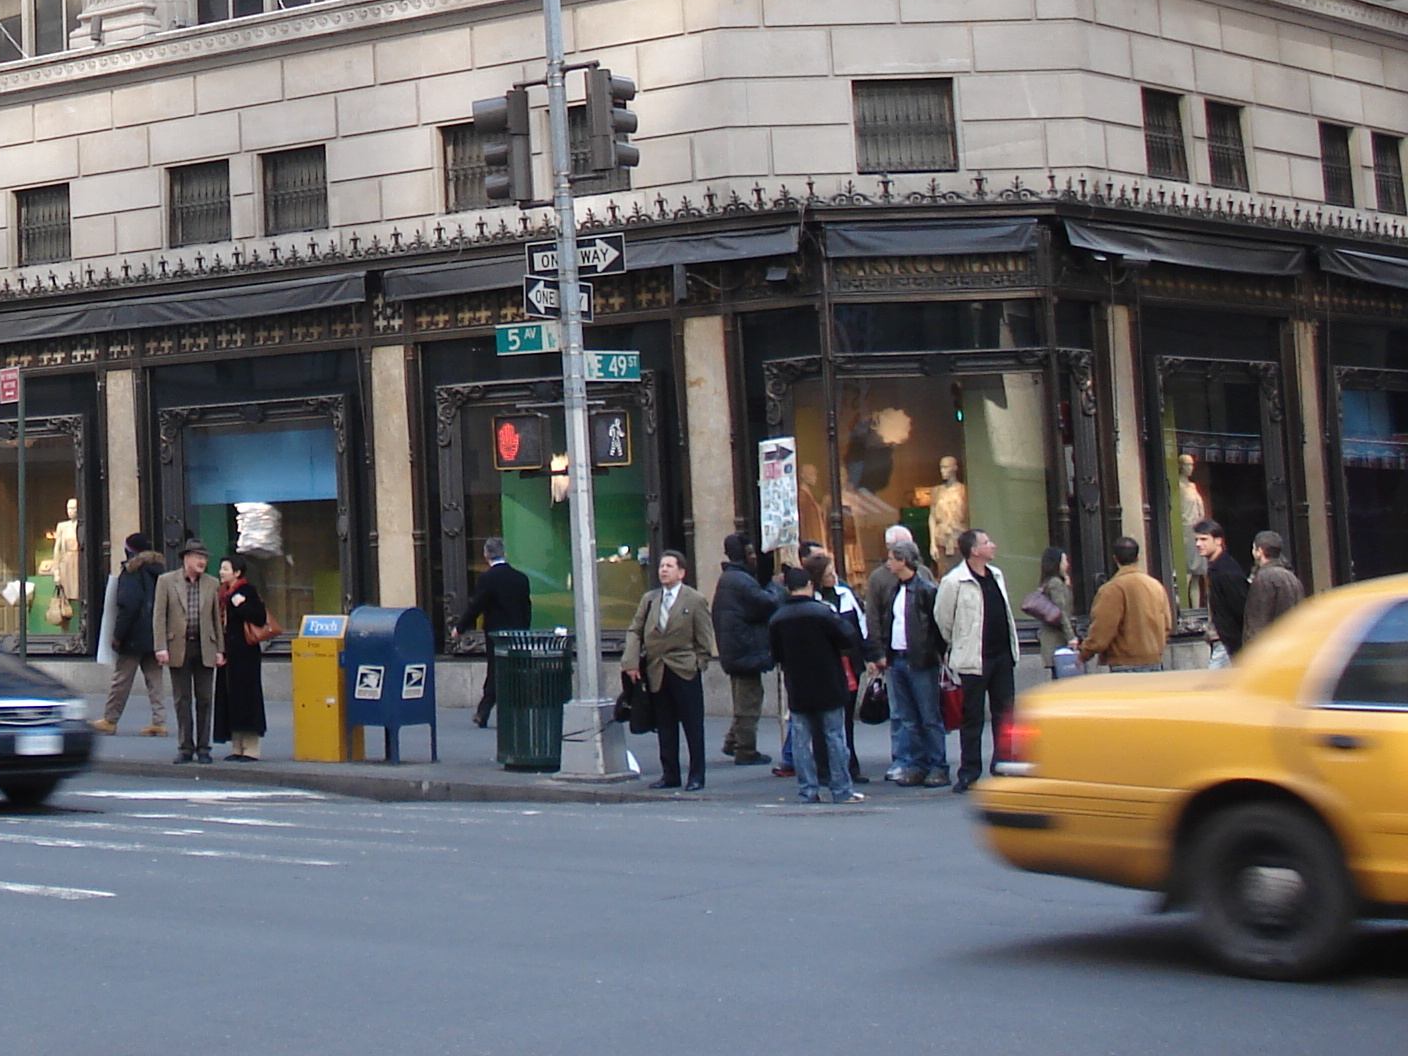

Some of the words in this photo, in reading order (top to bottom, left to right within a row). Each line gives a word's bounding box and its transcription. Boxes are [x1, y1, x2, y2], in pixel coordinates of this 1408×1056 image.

[541, 254, 559, 268] ON
[580, 248, 609, 264] WAY
[535, 289, 555, 305] ONE
[507, 328, 521, 351] 5
[524, 327, 536, 339] AV
[594, 355, 604, 377] E
[608, 355, 627, 377] 49
[628, 356, 637, 367] ST
[309, 620, 338, 634] Epoch
